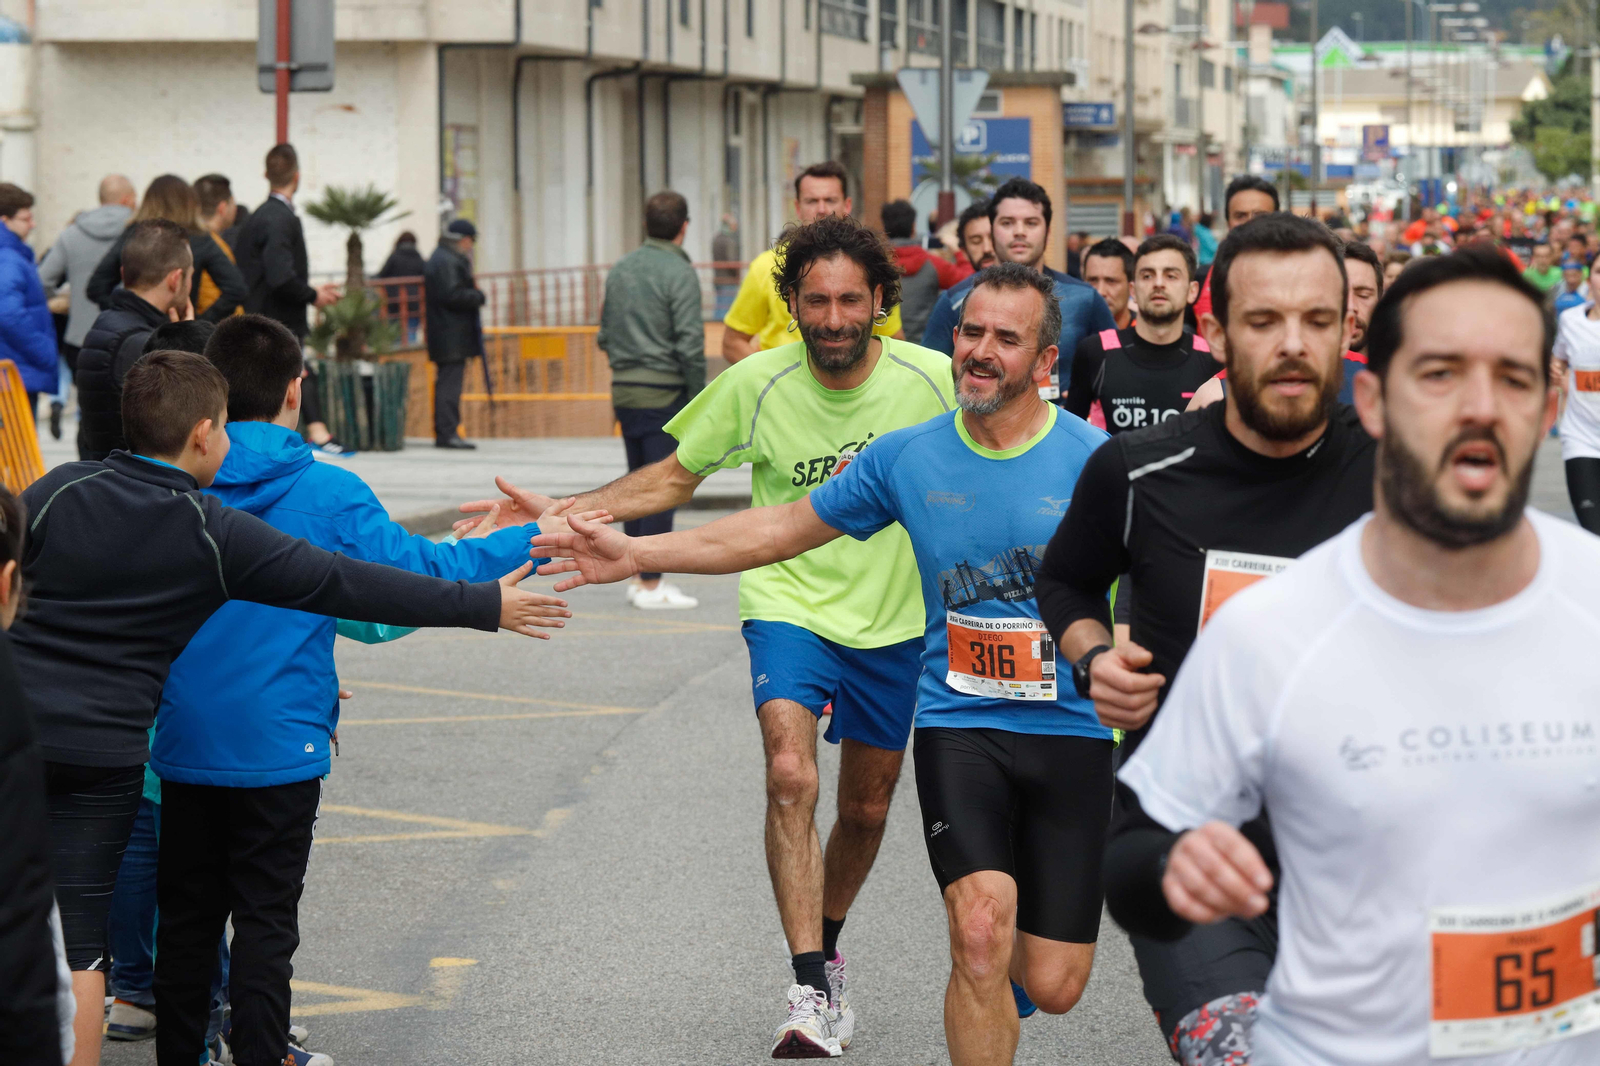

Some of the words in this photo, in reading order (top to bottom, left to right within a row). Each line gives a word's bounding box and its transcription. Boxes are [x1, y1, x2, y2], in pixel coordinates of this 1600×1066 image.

[1036, 507, 1066, 517] MIZU
[1003, 589, 1025, 600] PIZZA
[959, 617, 984, 629] CARREIRA
[1002, 620, 1033, 629] PORRIÑO
[978, 633, 1003, 642] DIEGO
[969, 641, 1016, 679] 316
[1398, 721, 1595, 751] COLISEUM
[1493, 947, 1556, 1013] 65
